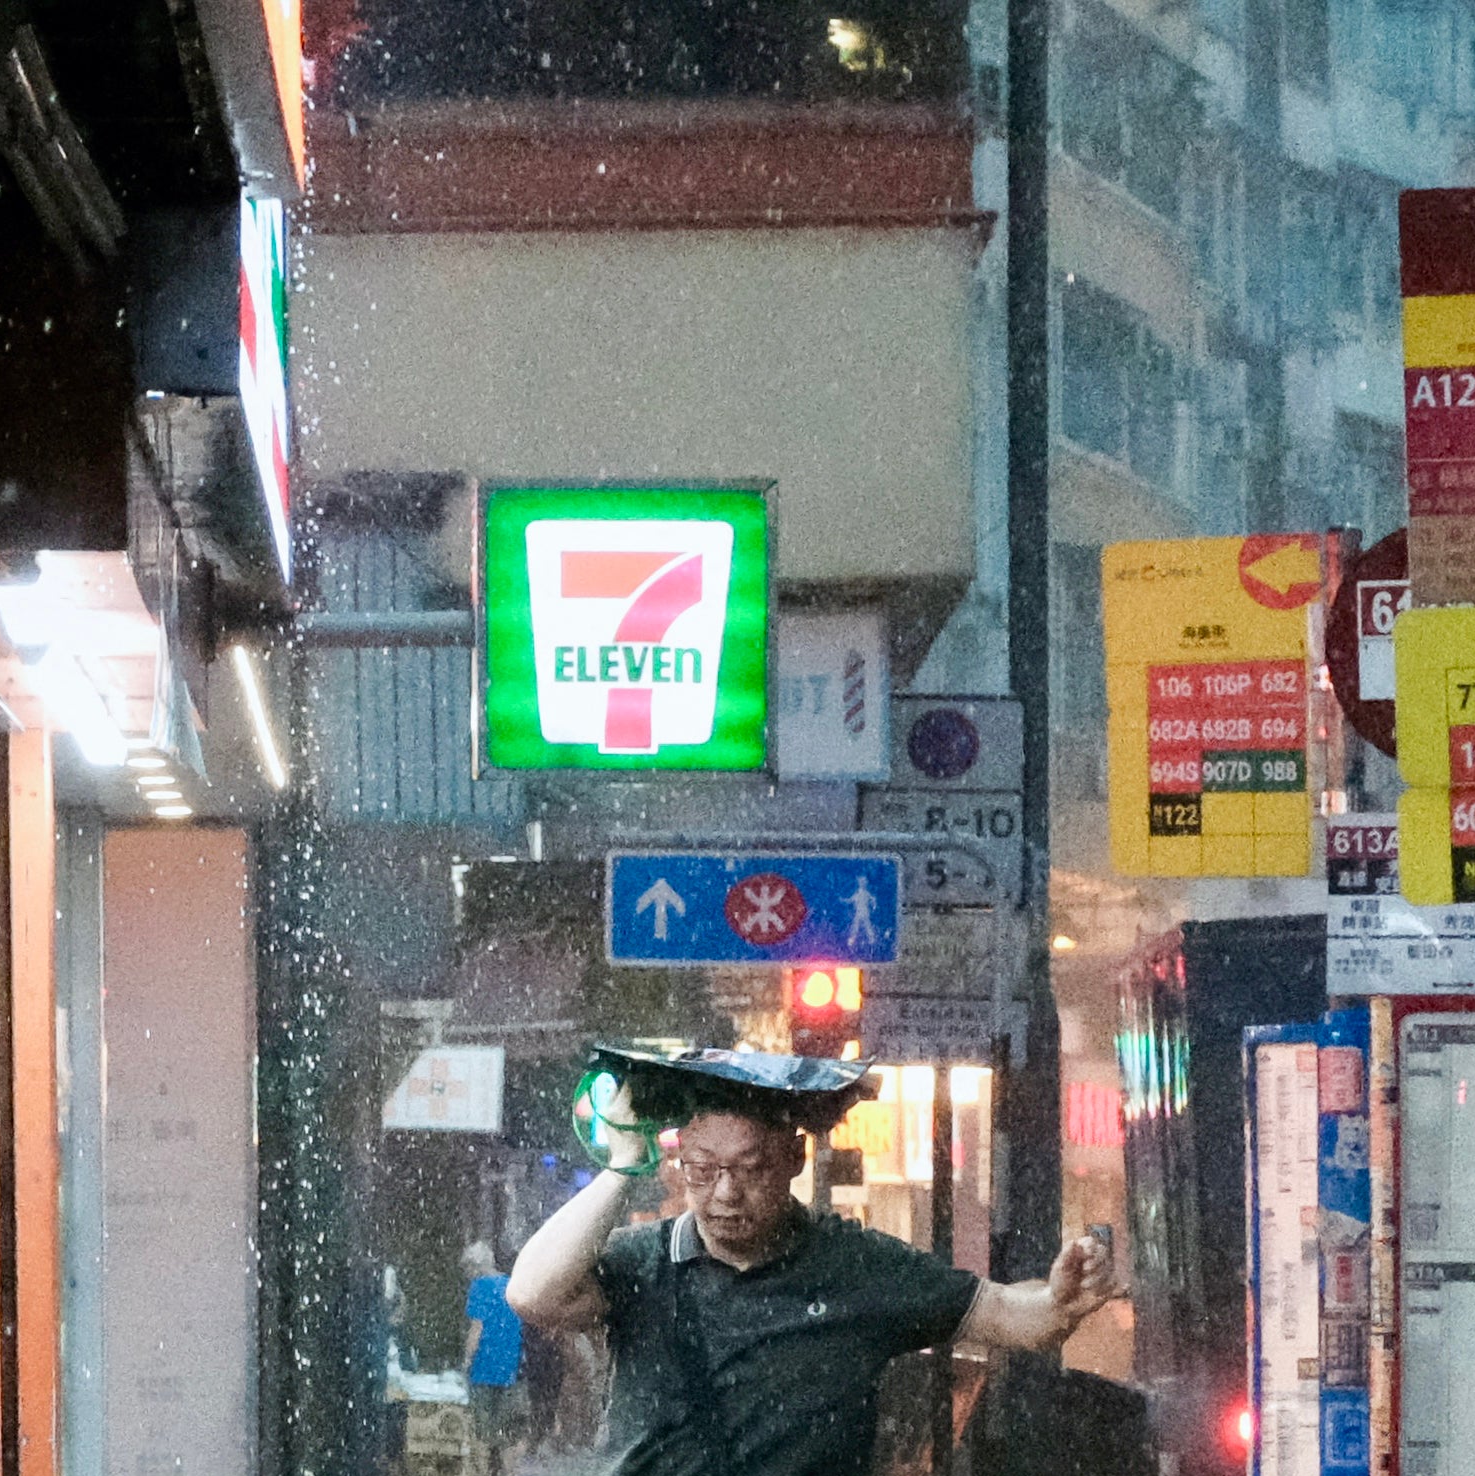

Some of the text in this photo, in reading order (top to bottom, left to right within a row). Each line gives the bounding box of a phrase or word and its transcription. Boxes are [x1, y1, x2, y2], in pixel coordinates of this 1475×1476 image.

[560, 551, 702, 748] 7
[1158, 671, 1297, 697] 106 106P 682
[1150, 717, 1297, 741] 682A 682B 694
[1151, 760, 1297, 782] 694S 907D 988
